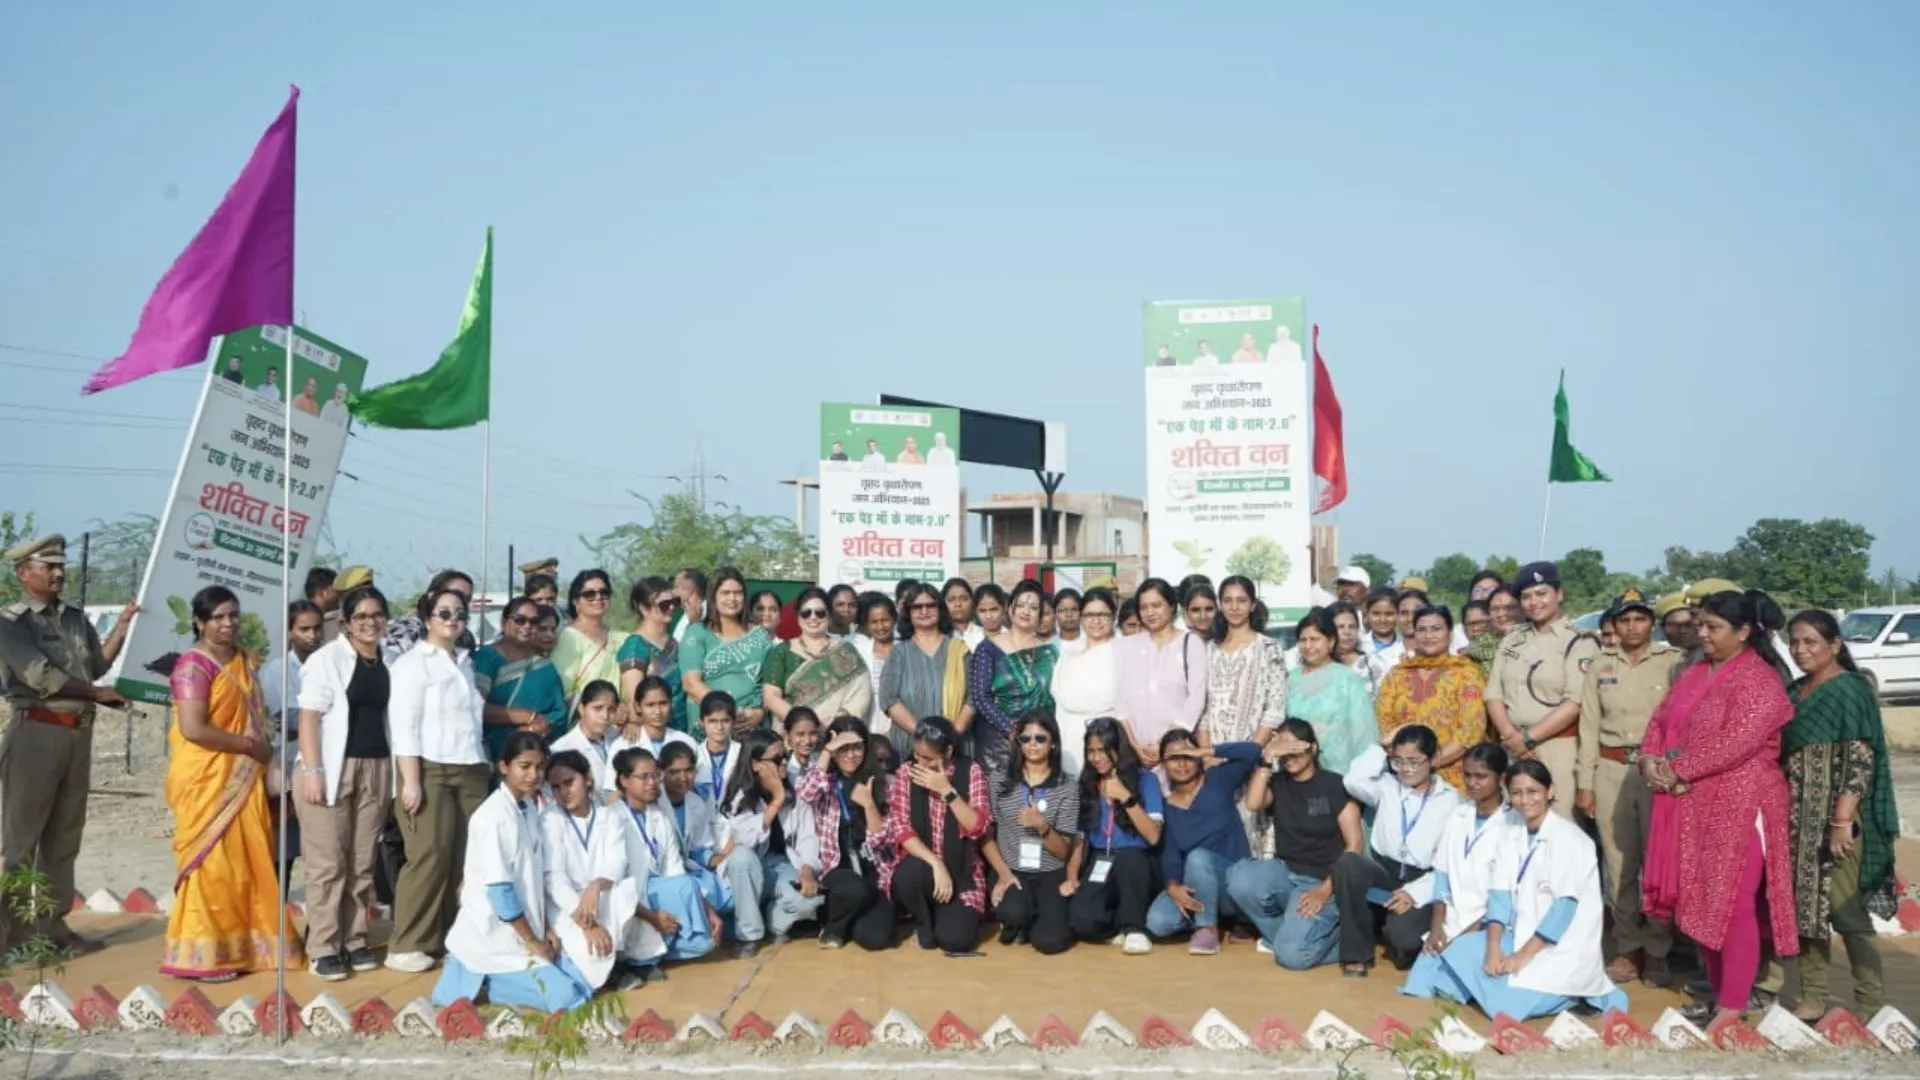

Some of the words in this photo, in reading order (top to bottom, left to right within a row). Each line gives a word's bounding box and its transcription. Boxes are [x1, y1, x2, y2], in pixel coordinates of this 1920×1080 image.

[1226, 415, 1238, 431] के
[1171, 438, 1241, 468] शक्ति
[1247, 443, 1291, 466] वन
[263, 464, 276, 483] के
[200, 480, 269, 526] शक्ति
[271, 505, 310, 539] वन
[891, 510, 901, 526] के
[843, 530, 905, 558] शक्ति
[909, 538, 946, 559] वन
